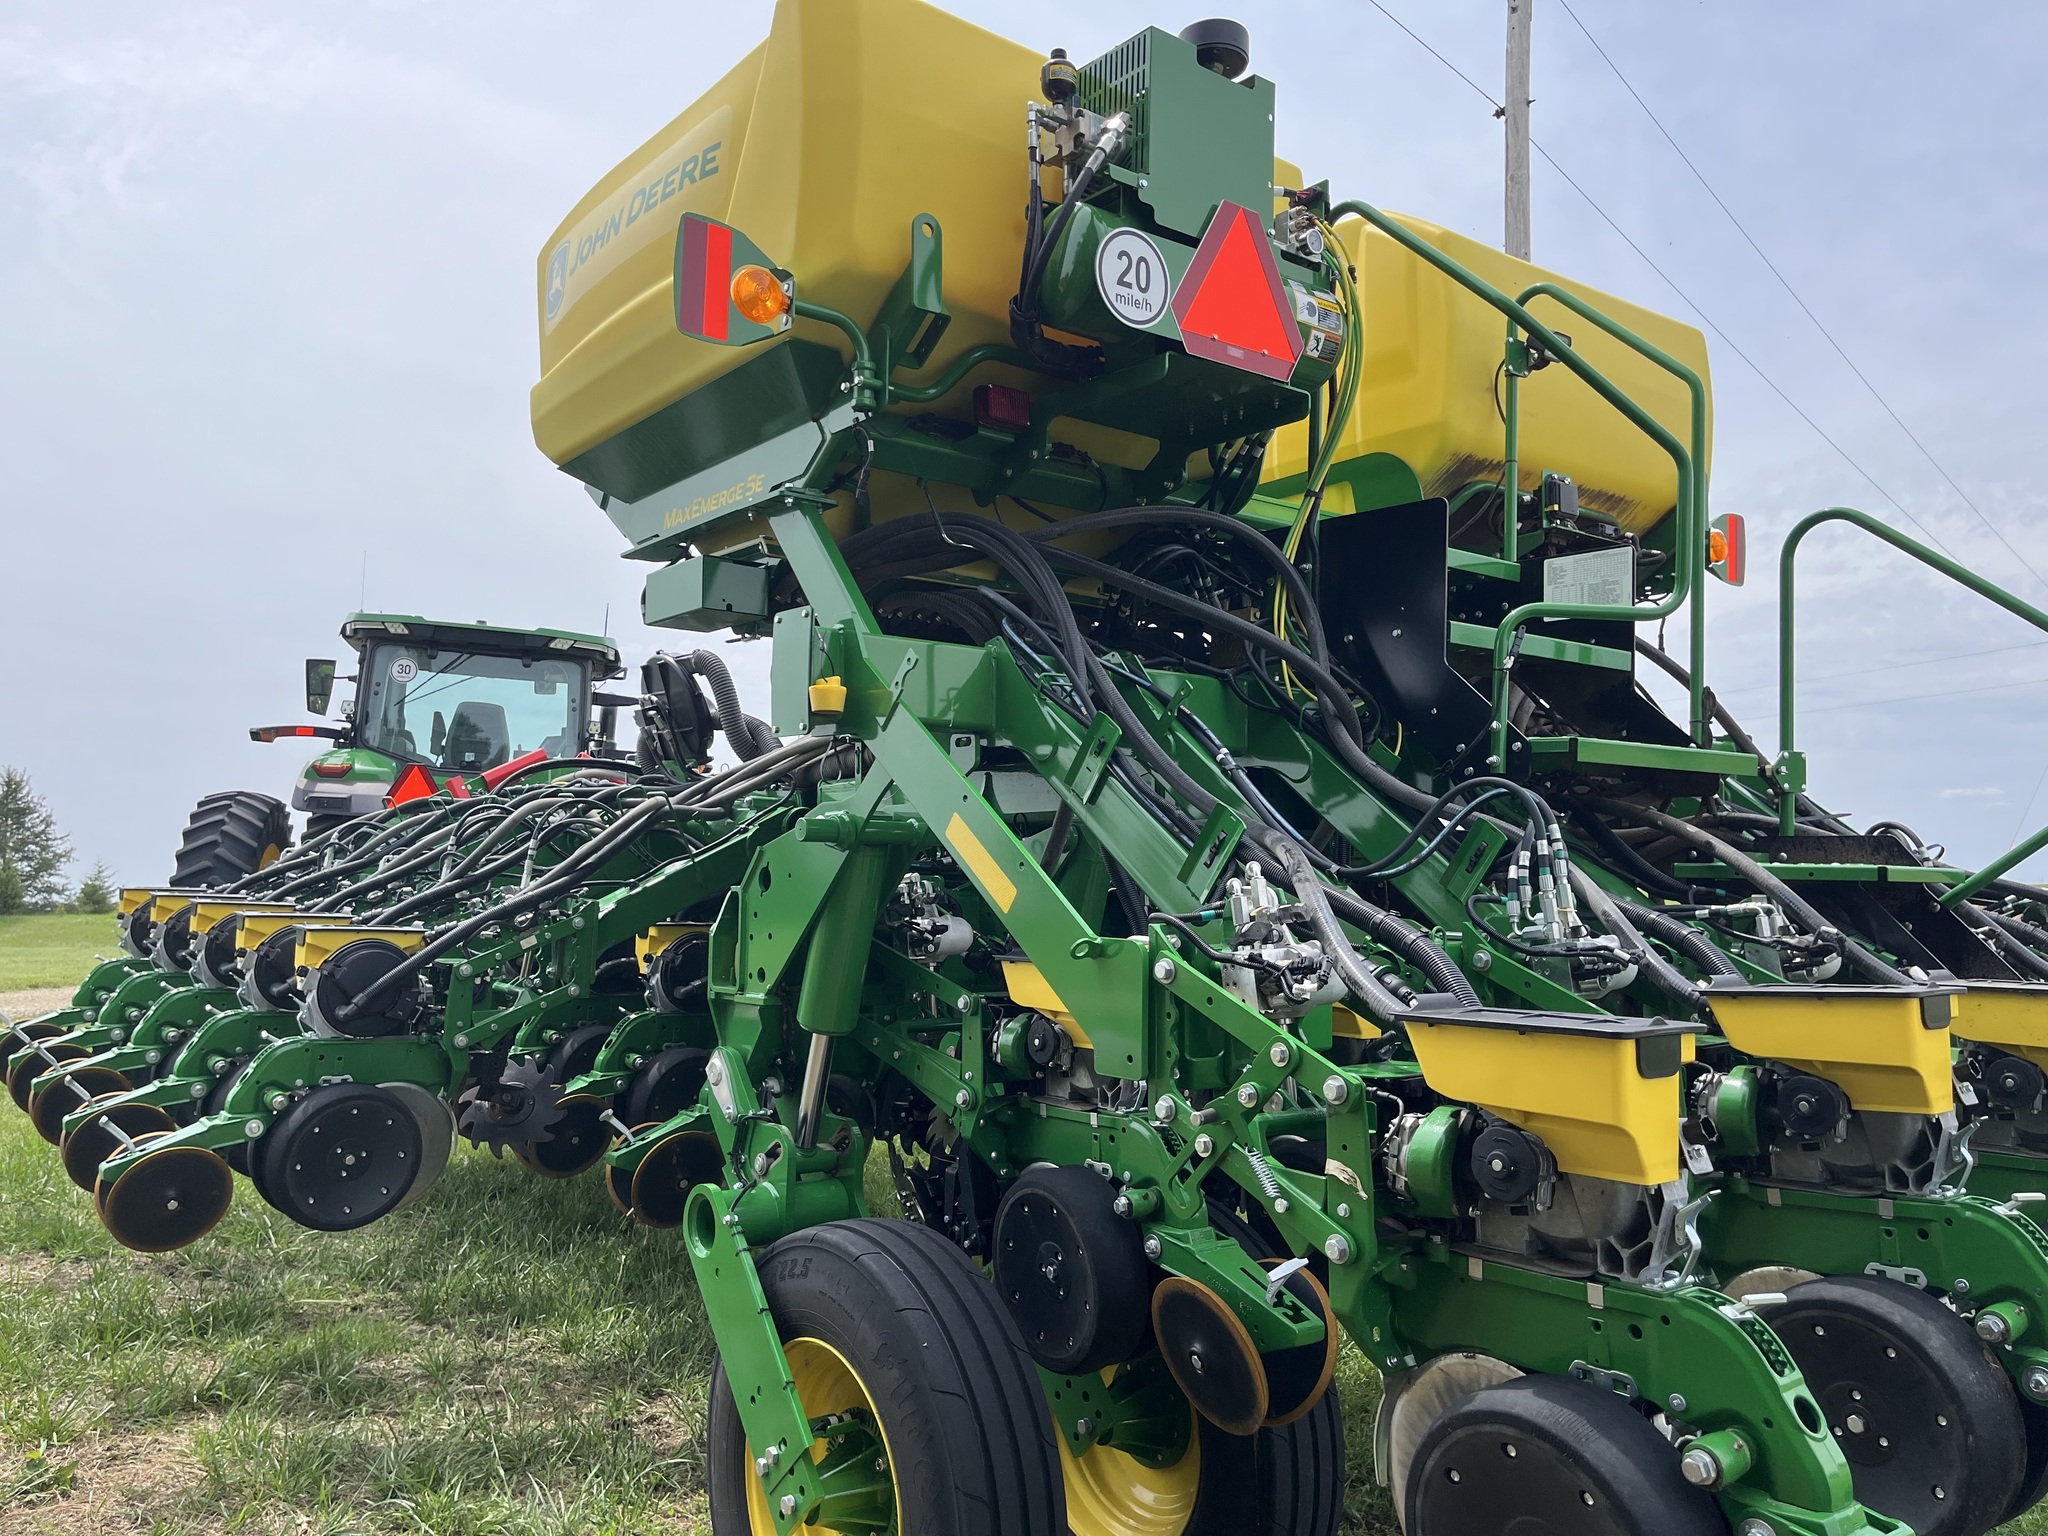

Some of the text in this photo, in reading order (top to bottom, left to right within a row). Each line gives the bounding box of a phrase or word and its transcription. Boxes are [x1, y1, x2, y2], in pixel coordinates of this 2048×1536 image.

[569, 141, 722, 277] JOHN DEERE
[1116, 249, 1151, 294] 20
[1115, 292, 1152, 313] mile/h
[397, 664, 411, 675] 30
